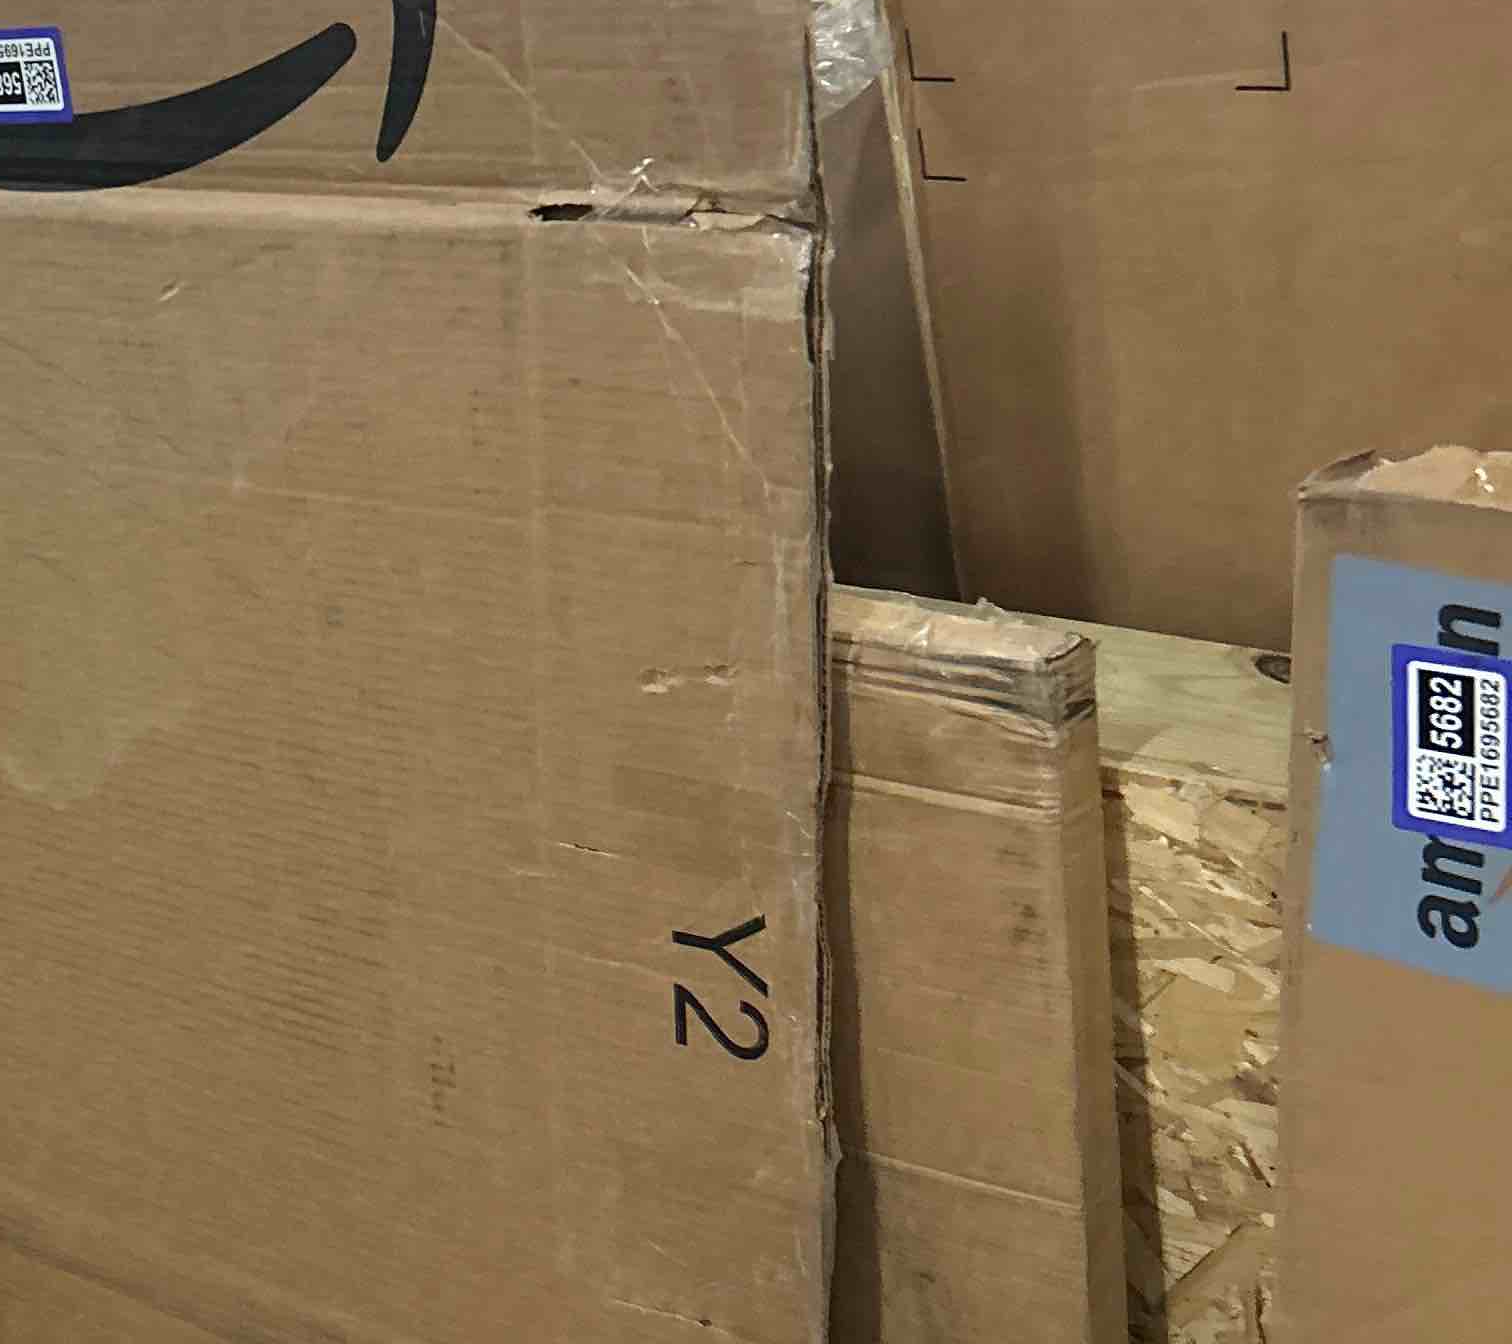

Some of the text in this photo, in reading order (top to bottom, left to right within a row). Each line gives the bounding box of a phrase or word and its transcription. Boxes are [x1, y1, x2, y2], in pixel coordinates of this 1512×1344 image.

[1427, 677, 1465, 748] 5682
[1480, 679, 1502, 824] PPE1695682
[672, 913, 770, 1061] Y2
